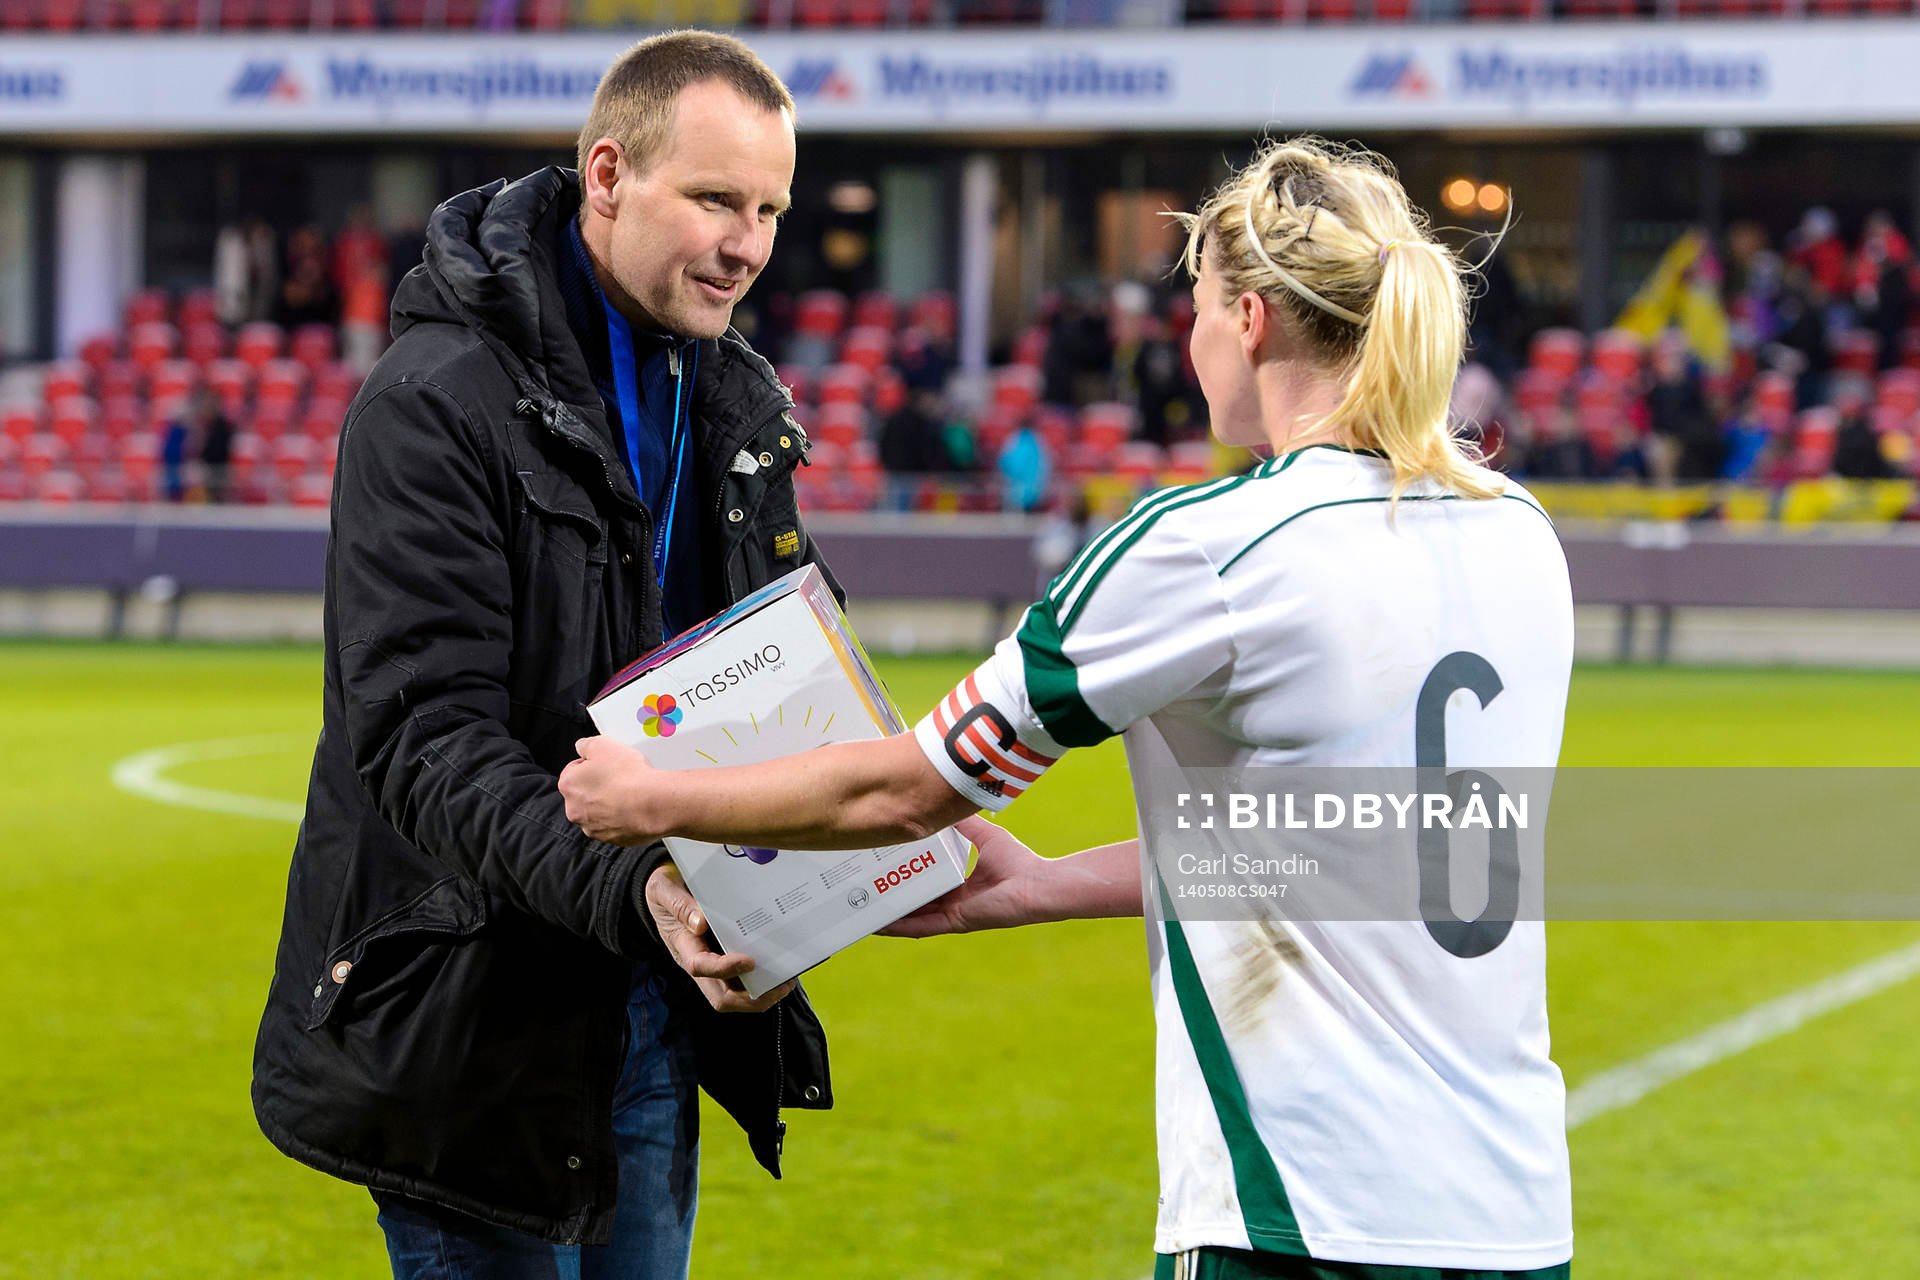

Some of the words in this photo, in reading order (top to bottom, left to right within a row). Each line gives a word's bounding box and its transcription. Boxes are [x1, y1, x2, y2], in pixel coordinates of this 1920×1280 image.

[944, 702, 1017, 777] C
[1416, 651, 1520, 958] 6
[873, 850, 936, 894] BOSCH
